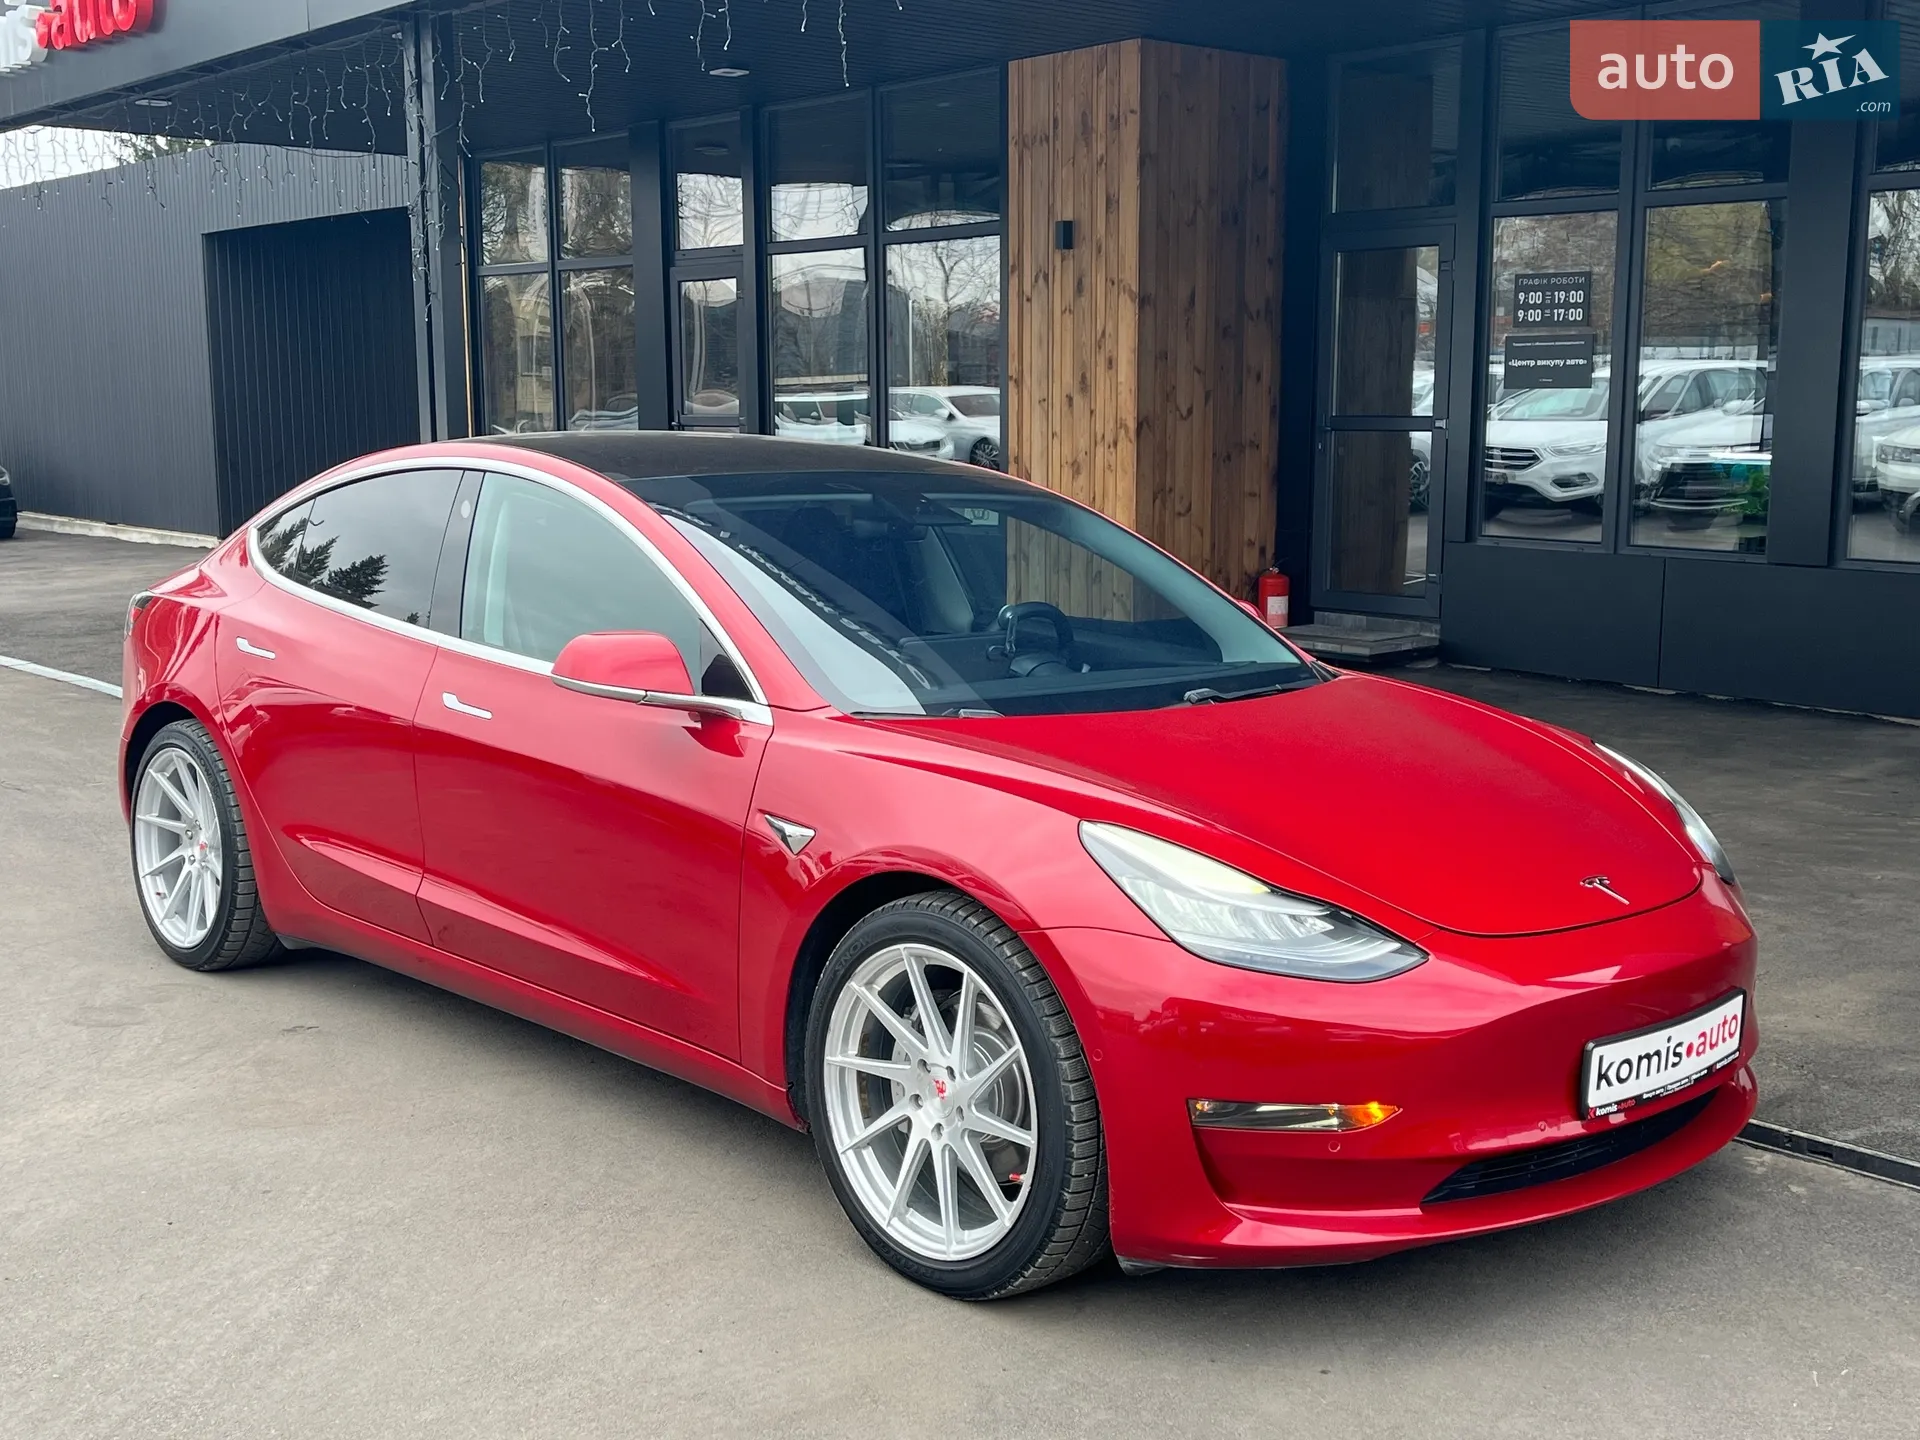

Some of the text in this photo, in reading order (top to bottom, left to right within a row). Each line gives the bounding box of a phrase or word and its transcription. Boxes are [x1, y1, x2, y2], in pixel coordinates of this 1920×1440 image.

[1518, 276, 1586, 287] ГРАФІК РОБОТИ
[1518, 290, 1584, 305] 9:00 19:00
[1517, 308, 1583, 322] 9:00 17:00
[1536, 359, 1564, 367] викупу
